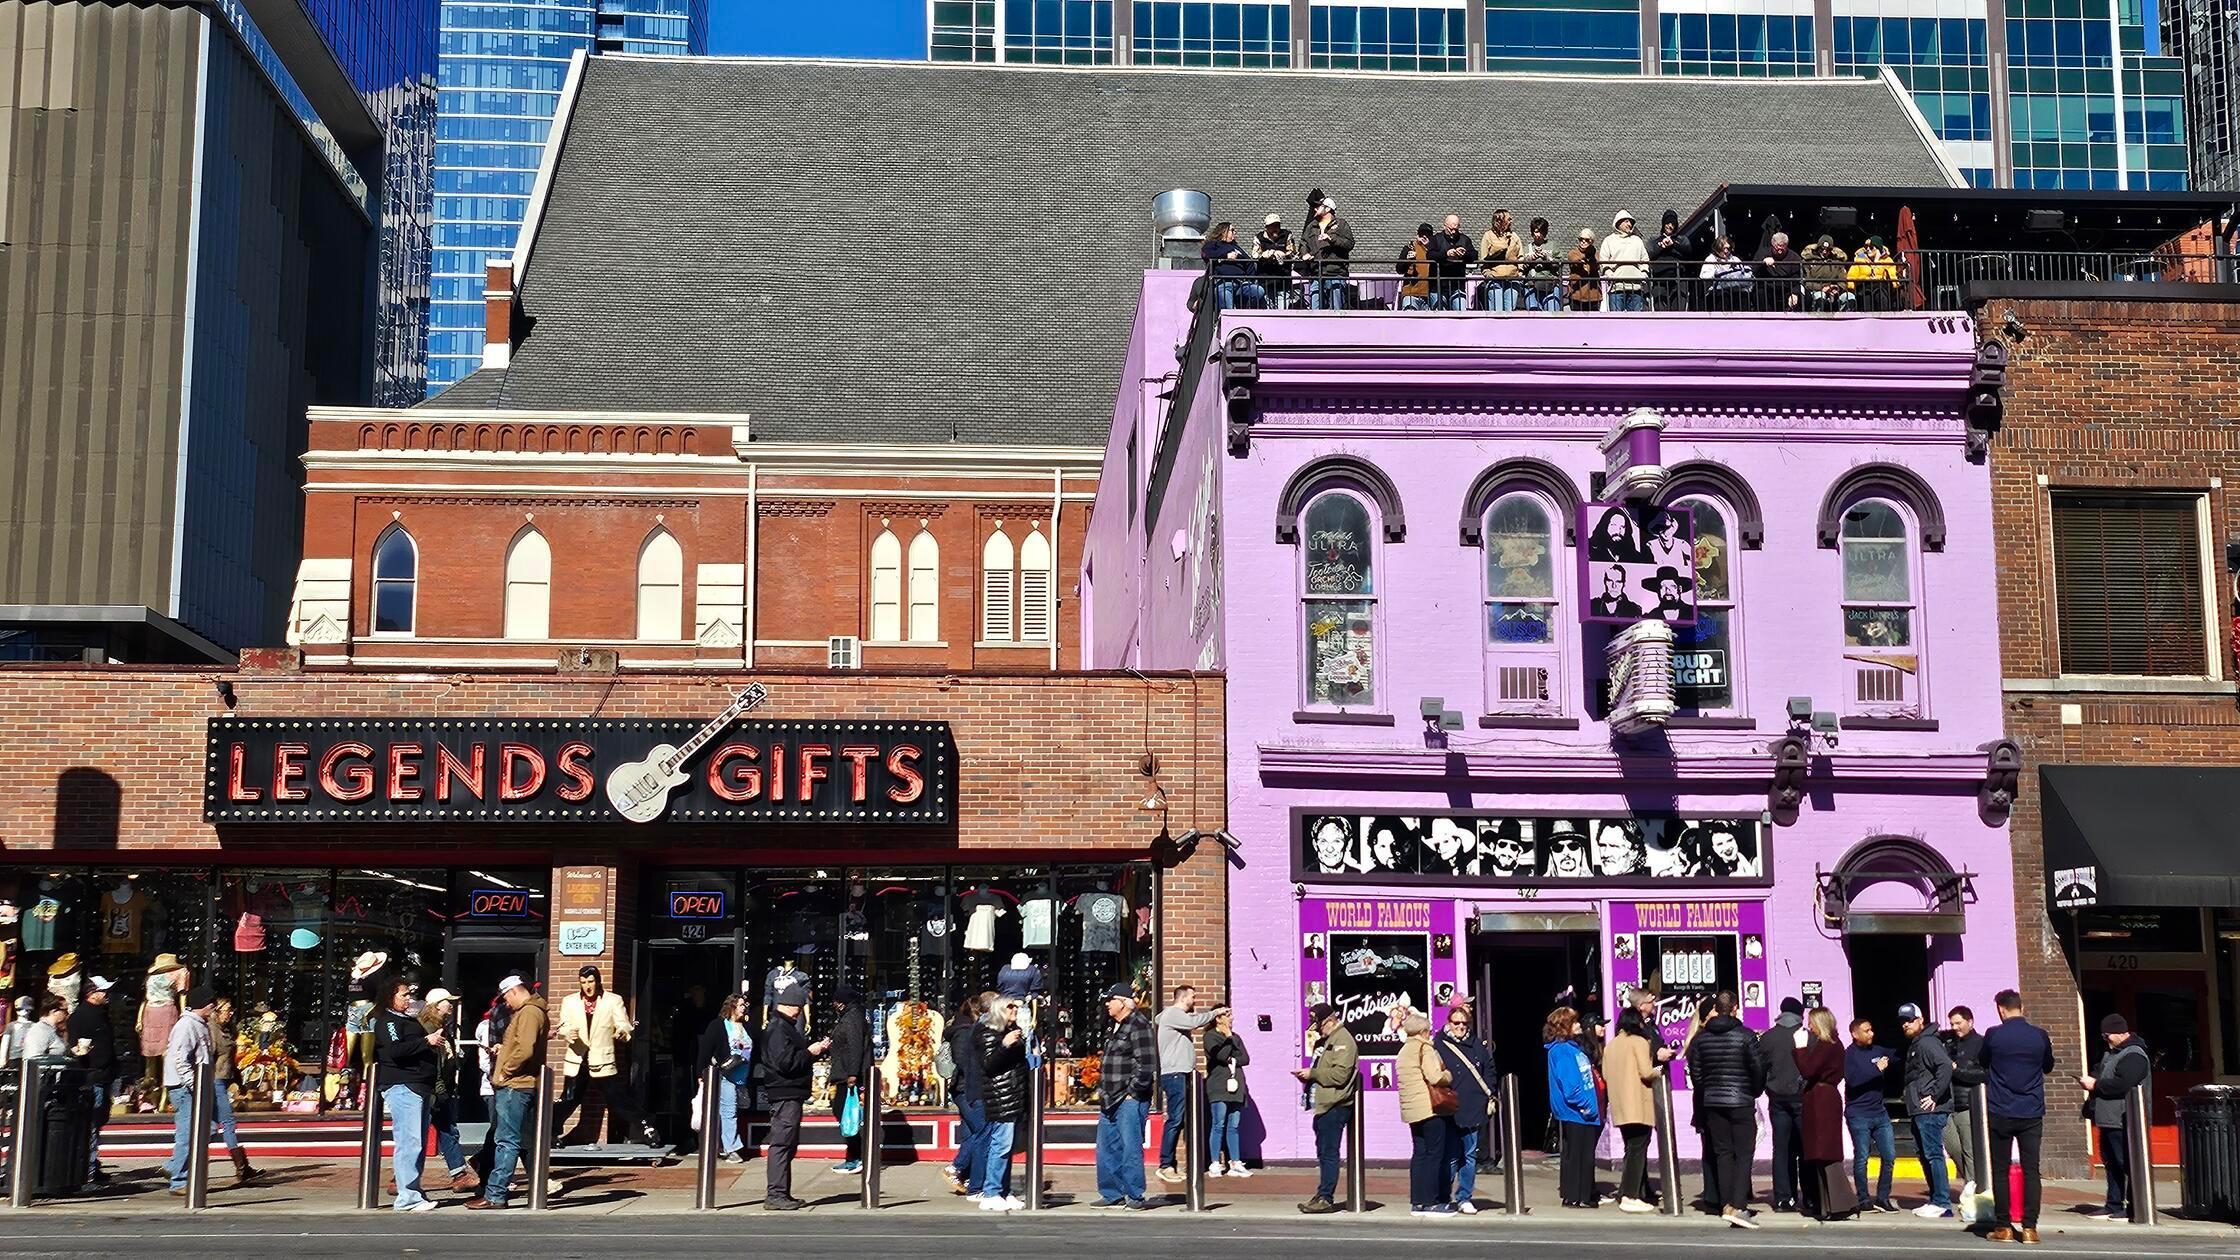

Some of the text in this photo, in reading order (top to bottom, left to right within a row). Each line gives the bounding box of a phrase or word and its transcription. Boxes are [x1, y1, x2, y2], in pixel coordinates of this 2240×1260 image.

[1308, 541, 1358, 550] ULTRA
[1672, 654, 1713, 669] BUD
[1675, 668, 1723, 684] IGHT
[227, 740, 924, 805] LEGENDS GIFTS
[475, 895, 525, 913] OPEN
[674, 896, 721, 914] OPEN
[1326, 902, 1430, 928] WORLD FAMOUS
[1635, 903, 1739, 928] WORLD FAMOUS
[683, 925, 705, 938] 424
[2107, 954, 2137, 969] 420
[1335, 991, 1398, 1023] Tootsies
[1355, 1032, 1400, 1042] OUNGE
[1665, 1027, 1687, 1037] ORC
